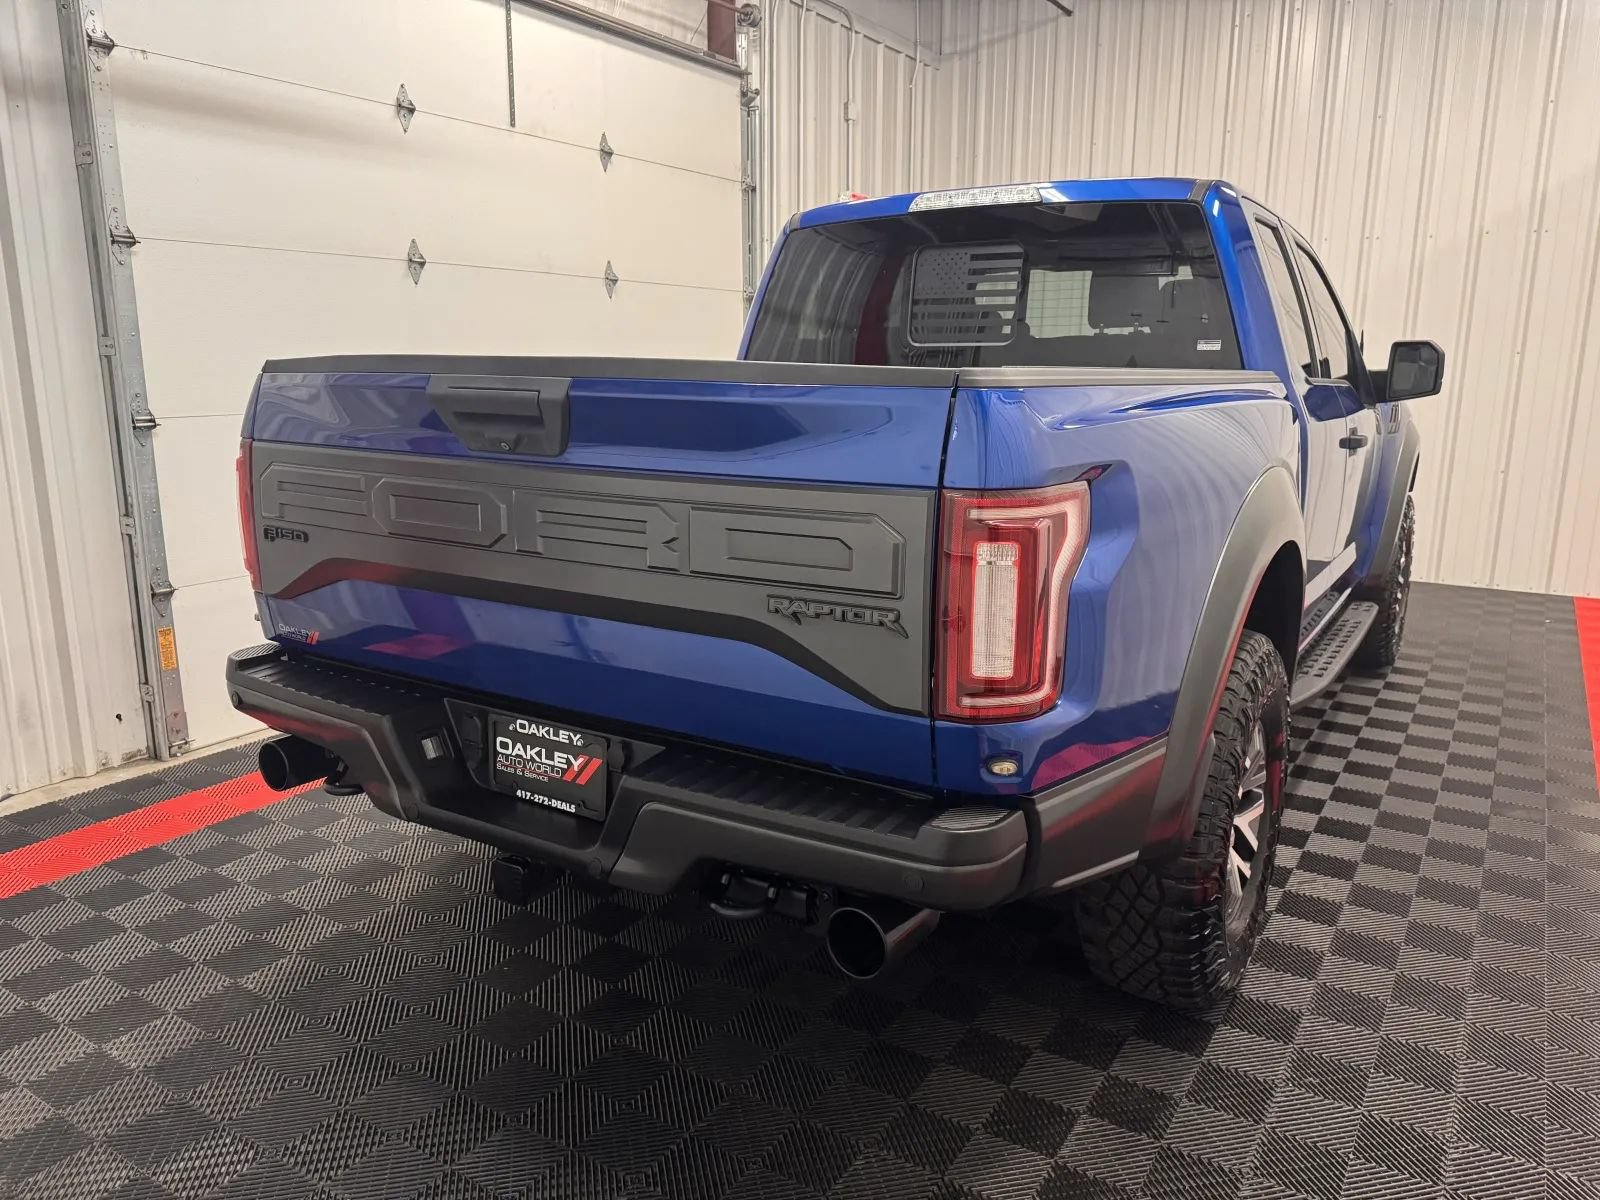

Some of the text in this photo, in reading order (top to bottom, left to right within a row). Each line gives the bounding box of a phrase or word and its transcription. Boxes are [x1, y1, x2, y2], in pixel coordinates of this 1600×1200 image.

[259, 462, 906, 599] FORD
[278, 623, 313, 637] OAKLEY
[767, 594, 909, 639] RAPTOR
[516, 719, 582, 746] OAKLEY
[496, 737, 585, 772] OAKLEY
[497, 754, 562, 779] AUTO WORLD
[516, 789, 576, 813] 417-272-DEALS
